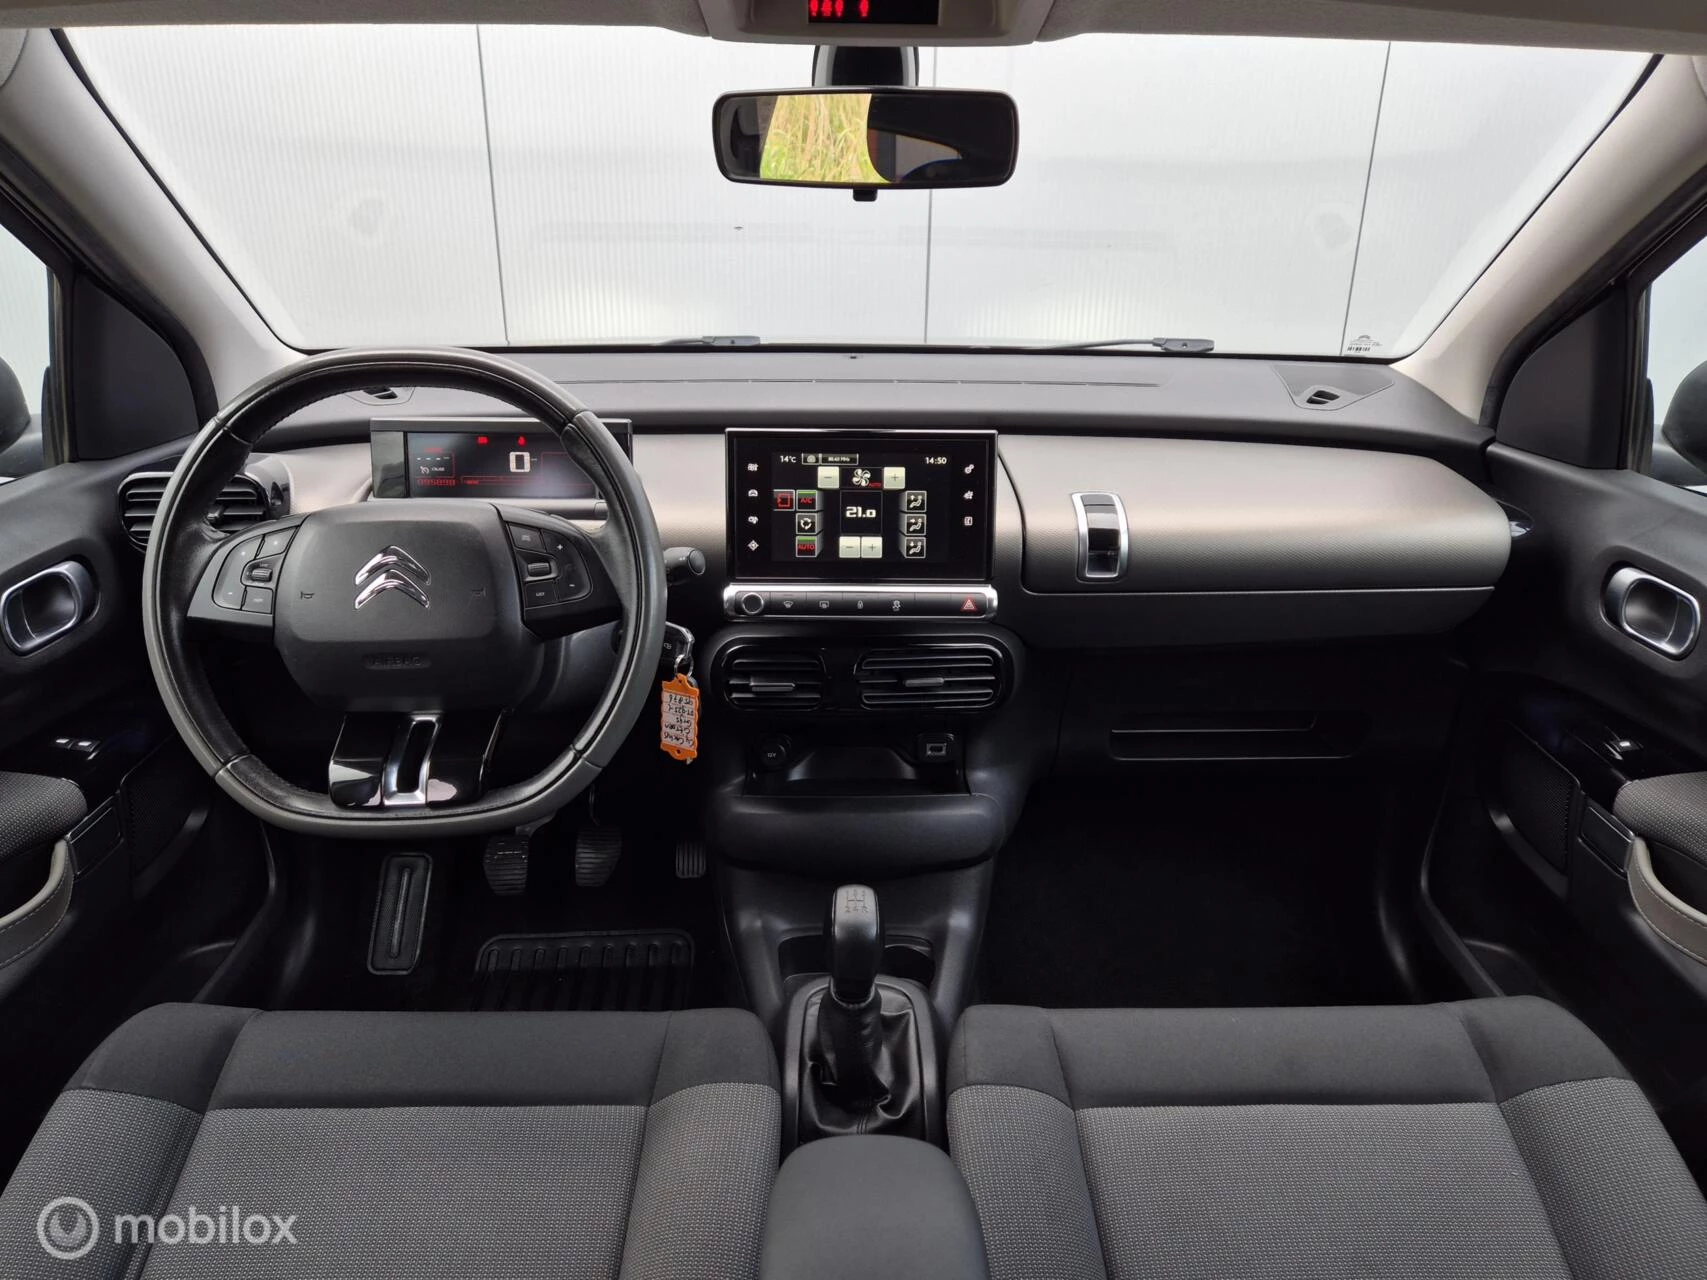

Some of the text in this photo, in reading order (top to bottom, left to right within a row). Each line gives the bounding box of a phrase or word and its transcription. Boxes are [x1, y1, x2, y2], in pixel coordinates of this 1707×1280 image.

[509, 451, 530, 473] 0
[780, 455, 797, 463] 14°C
[925, 455, 947, 465] 14:50
[845, 506, 877, 518] 21.0
[798, 543, 816, 551] AUTO
